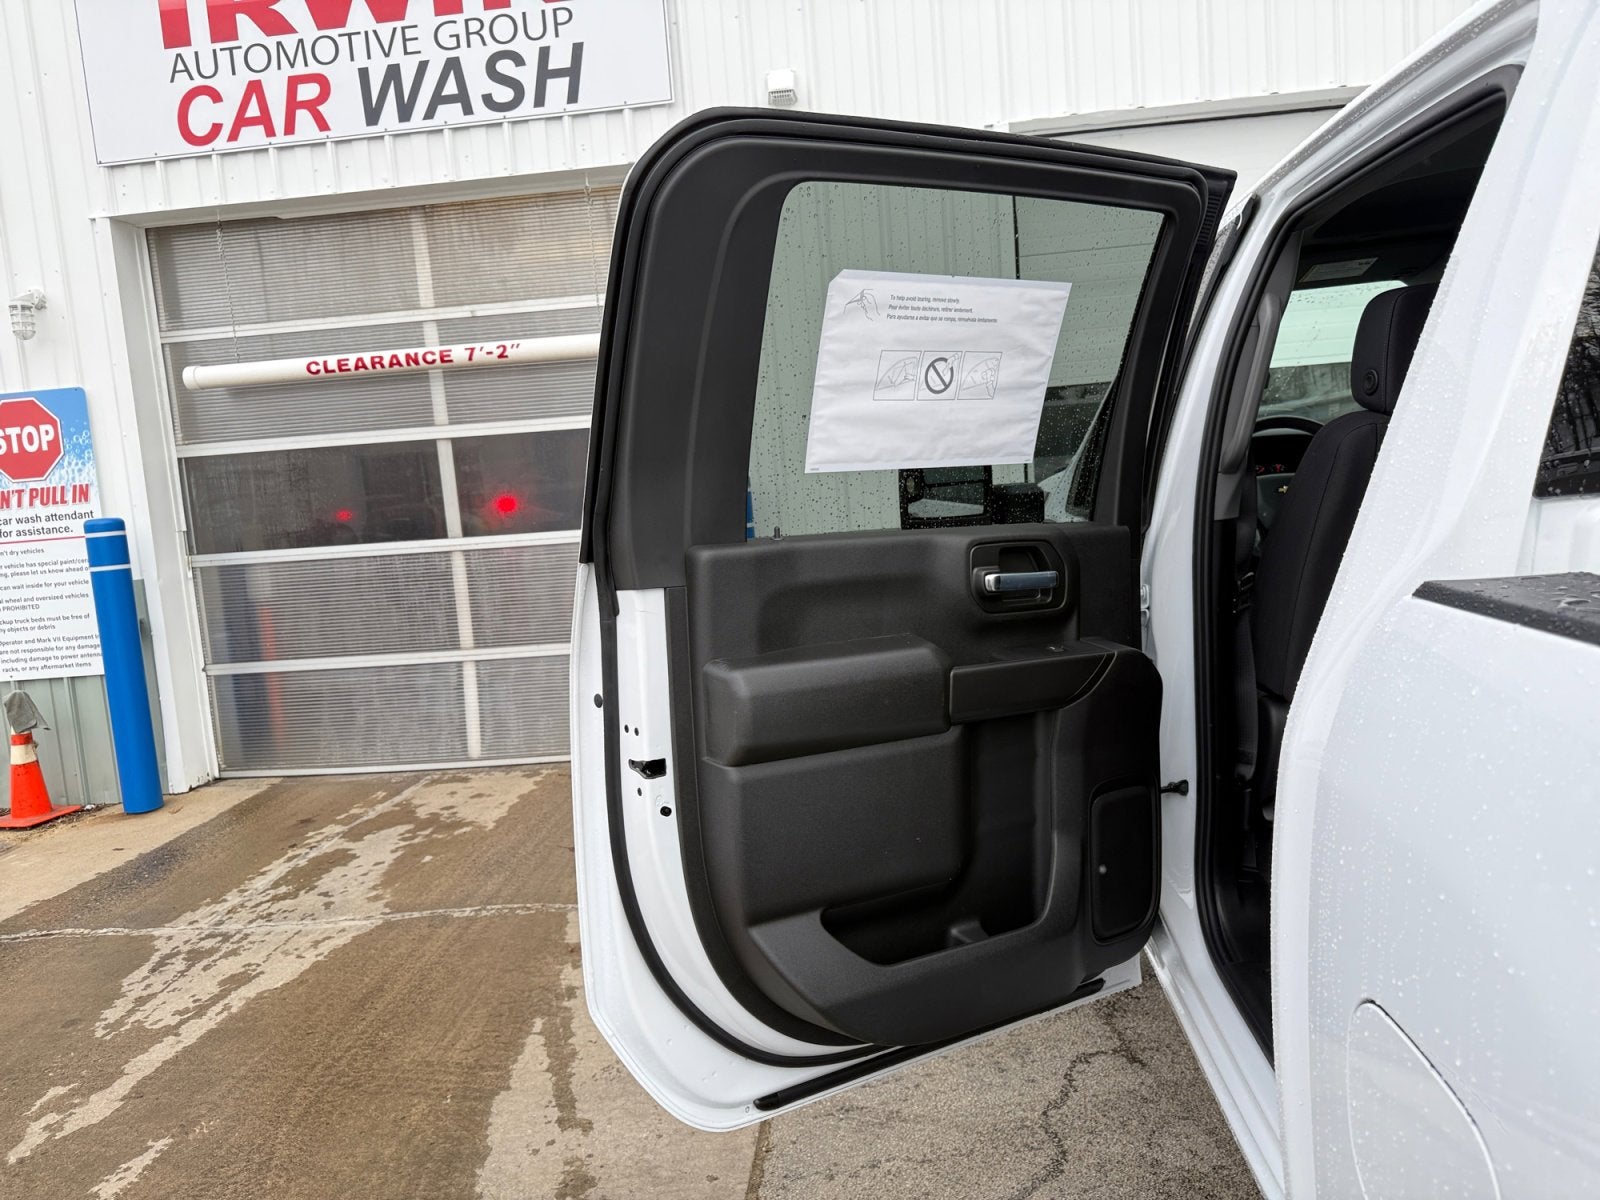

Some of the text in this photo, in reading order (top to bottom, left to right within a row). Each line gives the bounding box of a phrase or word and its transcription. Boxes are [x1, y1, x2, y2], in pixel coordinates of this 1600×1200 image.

[170, 24, 421, 83] AUTOMOTIVE
[433, 7, 573, 50] GROUP
[177, 42, 584, 146] CAR WASH
[306, 349, 454, 375] CLEARANCE
[0, 483, 89, 509] N'T PULL IN
[15, 513, 42, 524] wash
[44, 510, 94, 523] attendant
[16, 525, 73, 537] assistance.
[37, 558, 59, 568] special
[10, 571, 30, 579] please
[48, 566, 64, 574] know
[36, 594, 64, 602] oversized
[2, 603, 40, 612] PROHIBITED
[7, 626, 29, 634] objects
[0, 639, 23, 647] perator
[62, 633, 94, 643] Equipment
[21, 644, 55, 655] responsible
[1, 656, 28, 664] including
[40, 661, 74, 670] aftermarket
